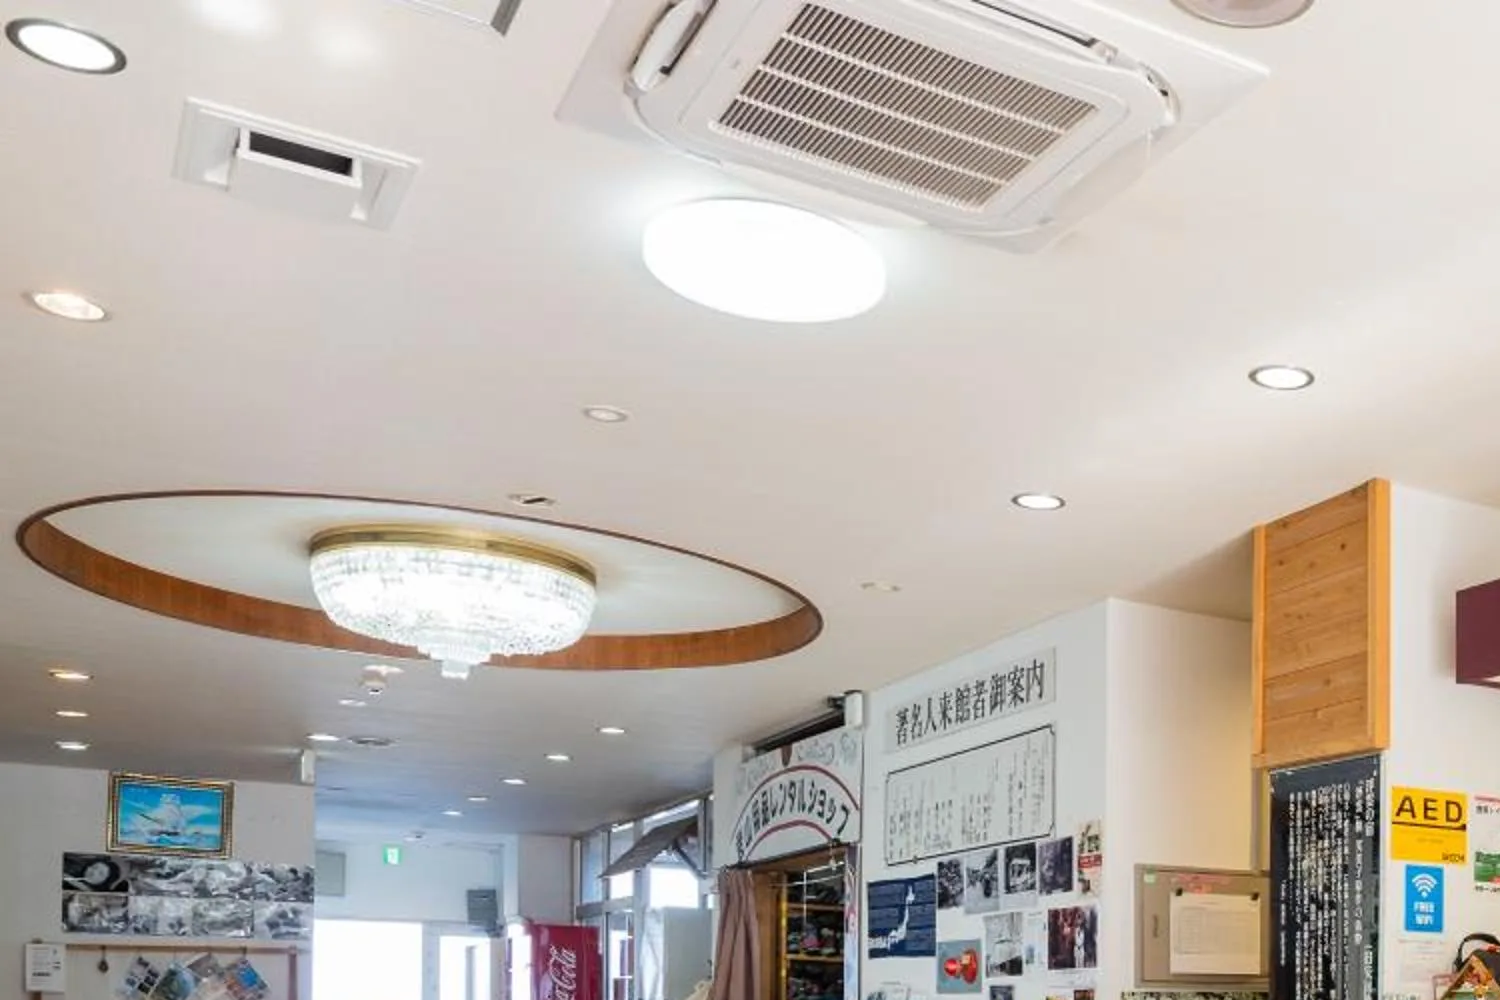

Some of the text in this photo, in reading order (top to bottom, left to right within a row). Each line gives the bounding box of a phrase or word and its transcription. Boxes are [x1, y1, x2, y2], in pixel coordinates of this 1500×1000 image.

[896, 658, 1045, 745] 著名人来館者御案内
[1395, 796, 1463, 824] AED
